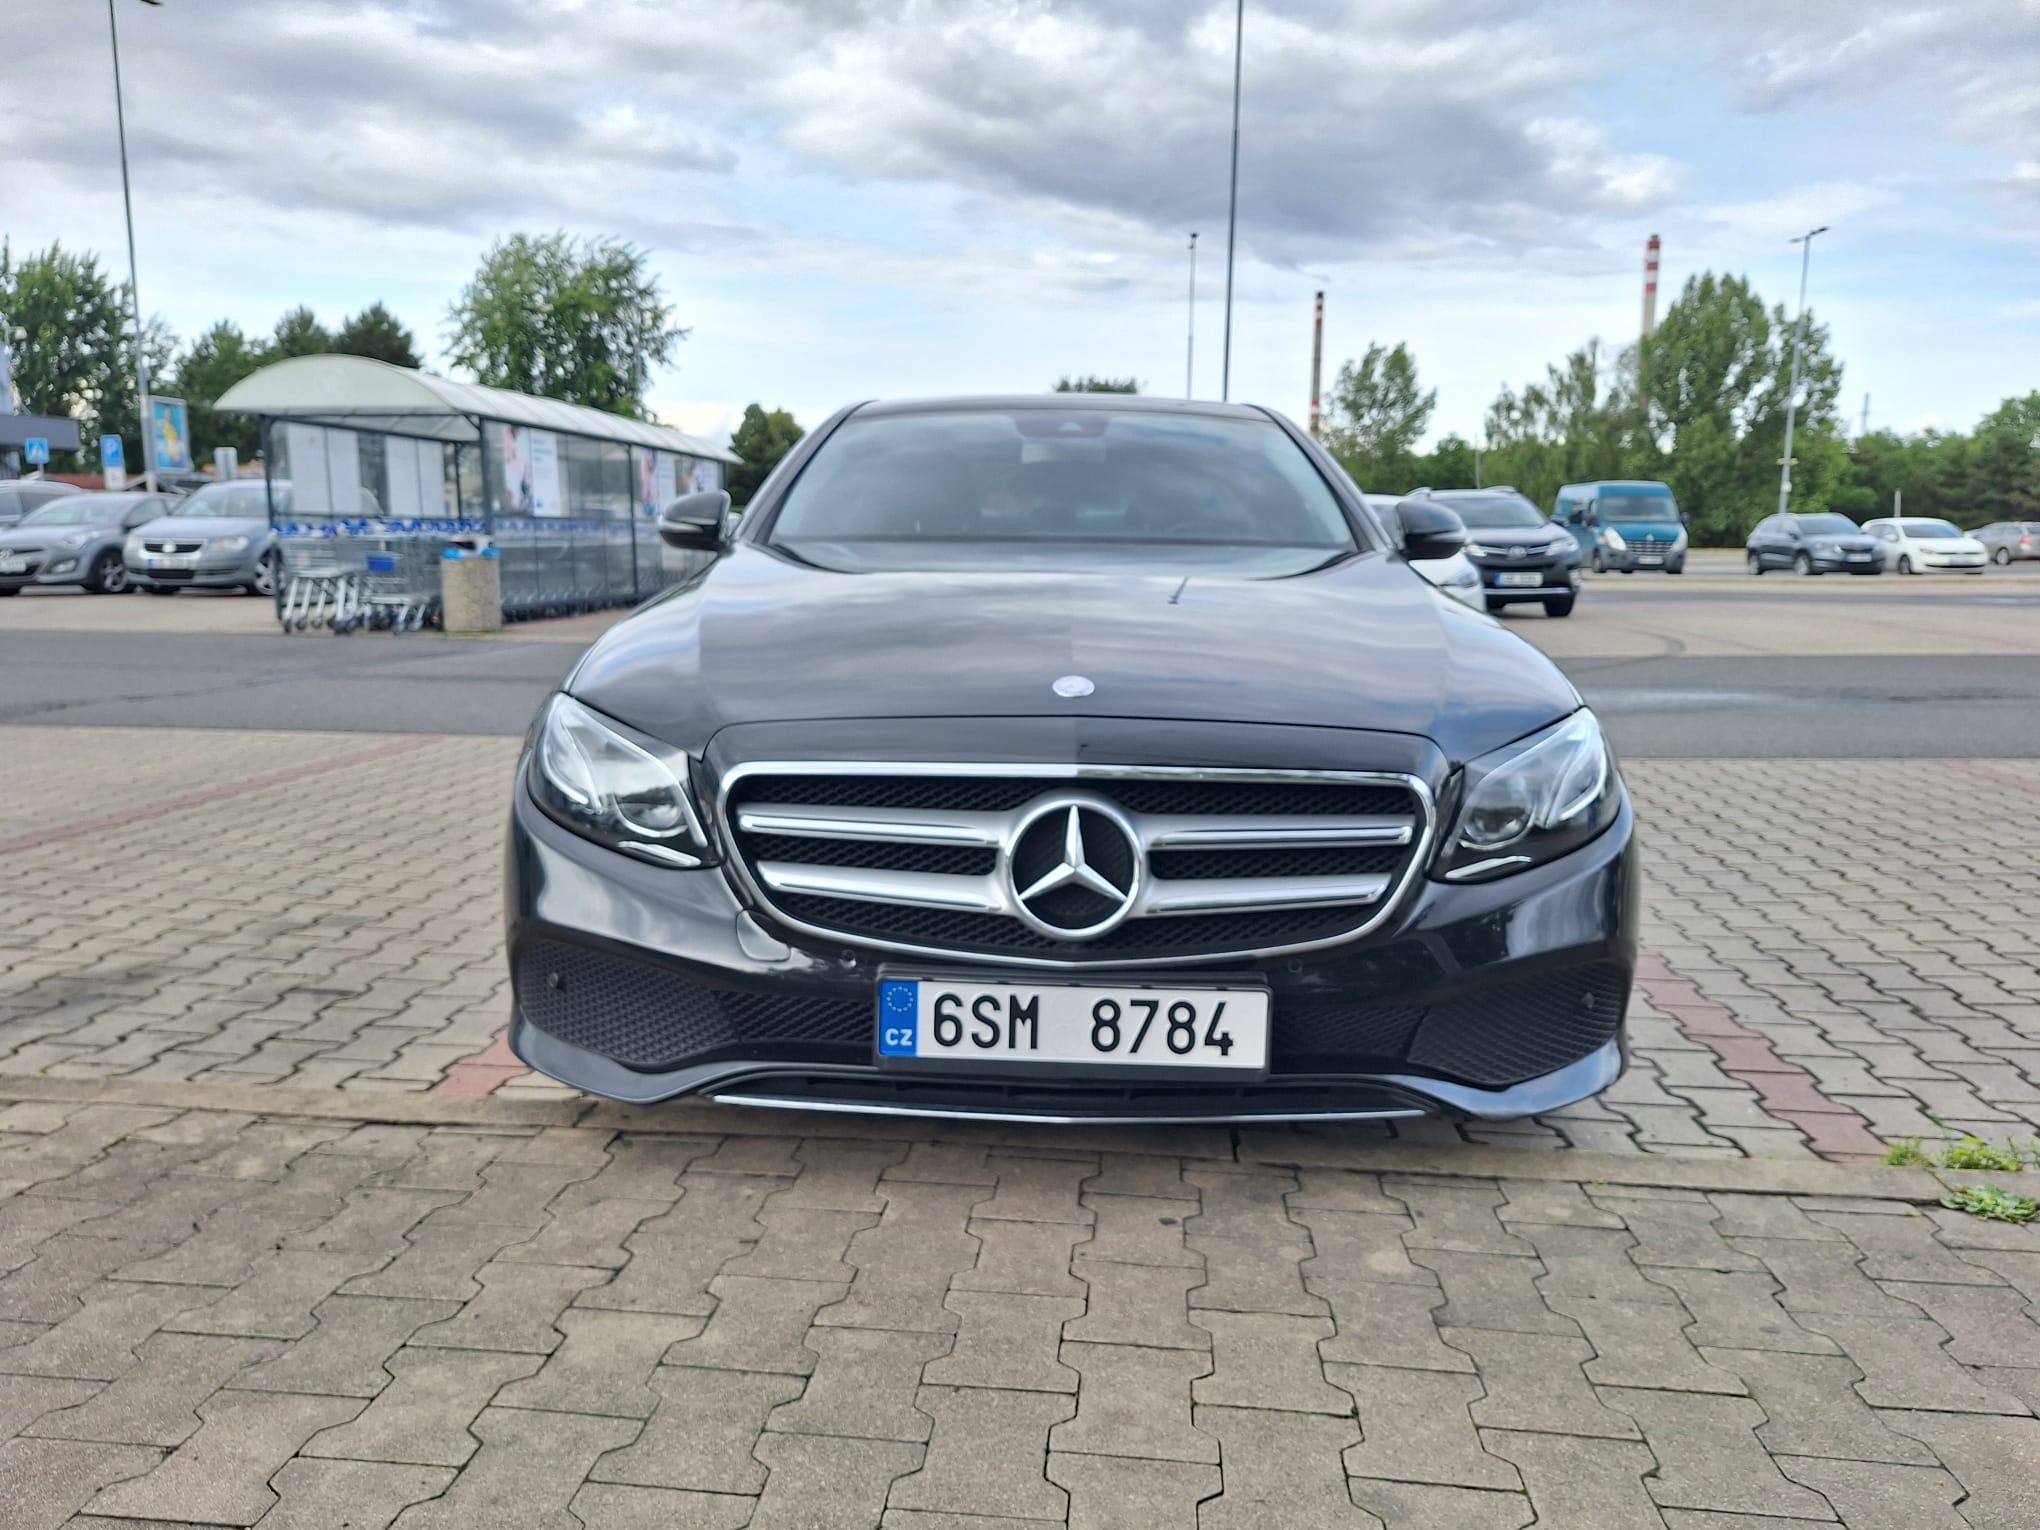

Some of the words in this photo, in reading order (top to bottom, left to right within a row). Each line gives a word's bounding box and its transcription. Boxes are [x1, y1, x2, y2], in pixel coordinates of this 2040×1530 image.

[885, 1028, 913, 1047] CZ
[932, 993, 1039, 1050] 6SM
[1090, 998, 1234, 1057] 8784
